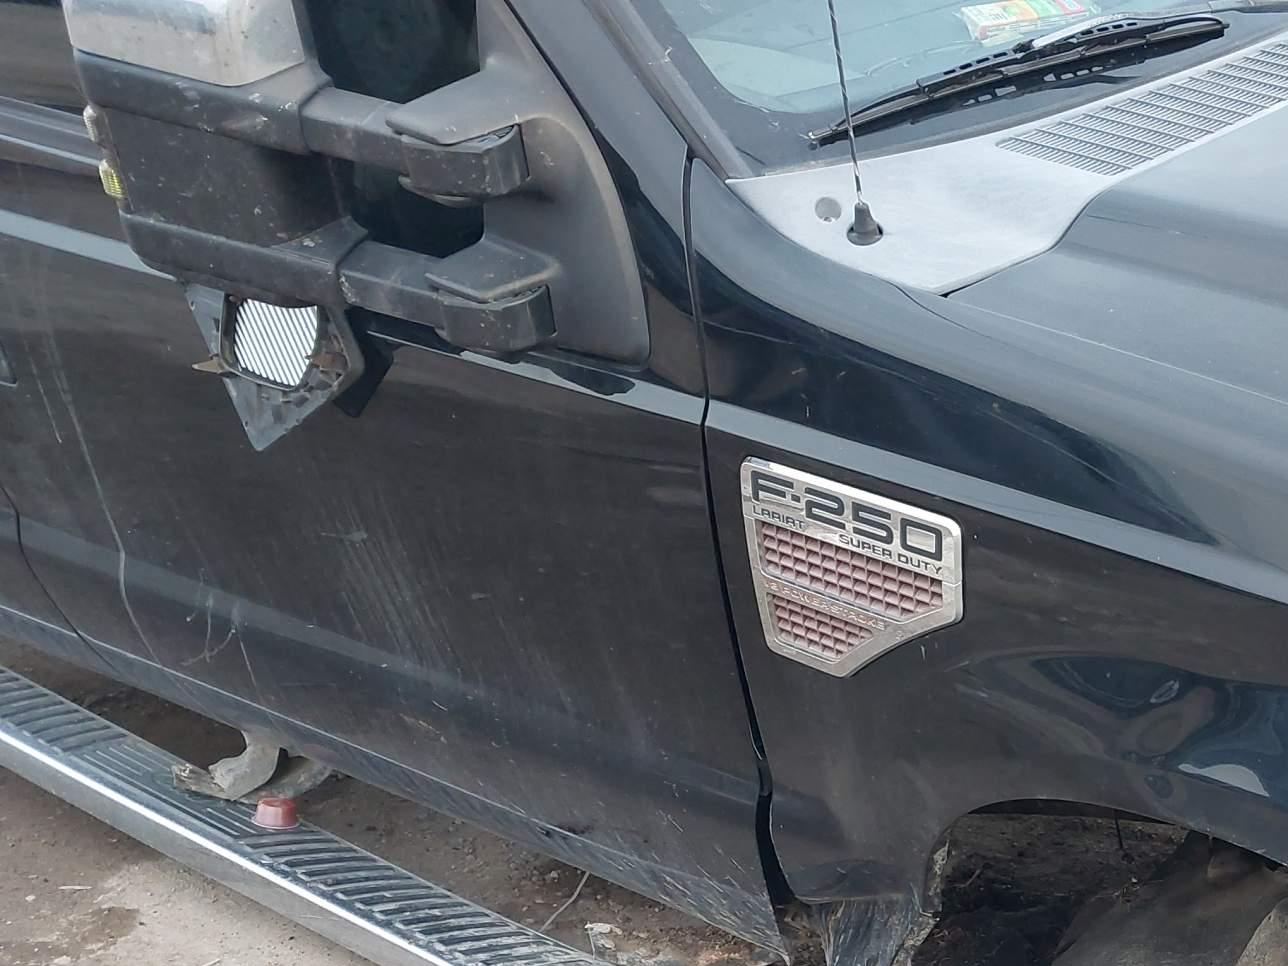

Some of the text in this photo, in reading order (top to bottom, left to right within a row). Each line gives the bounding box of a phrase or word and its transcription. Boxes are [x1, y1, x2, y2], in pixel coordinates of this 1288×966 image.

[751, 470, 942, 562] F-250
[753, 505, 806, 530] LARIAT
[839, 534, 943, 575] SUPER DUTY
